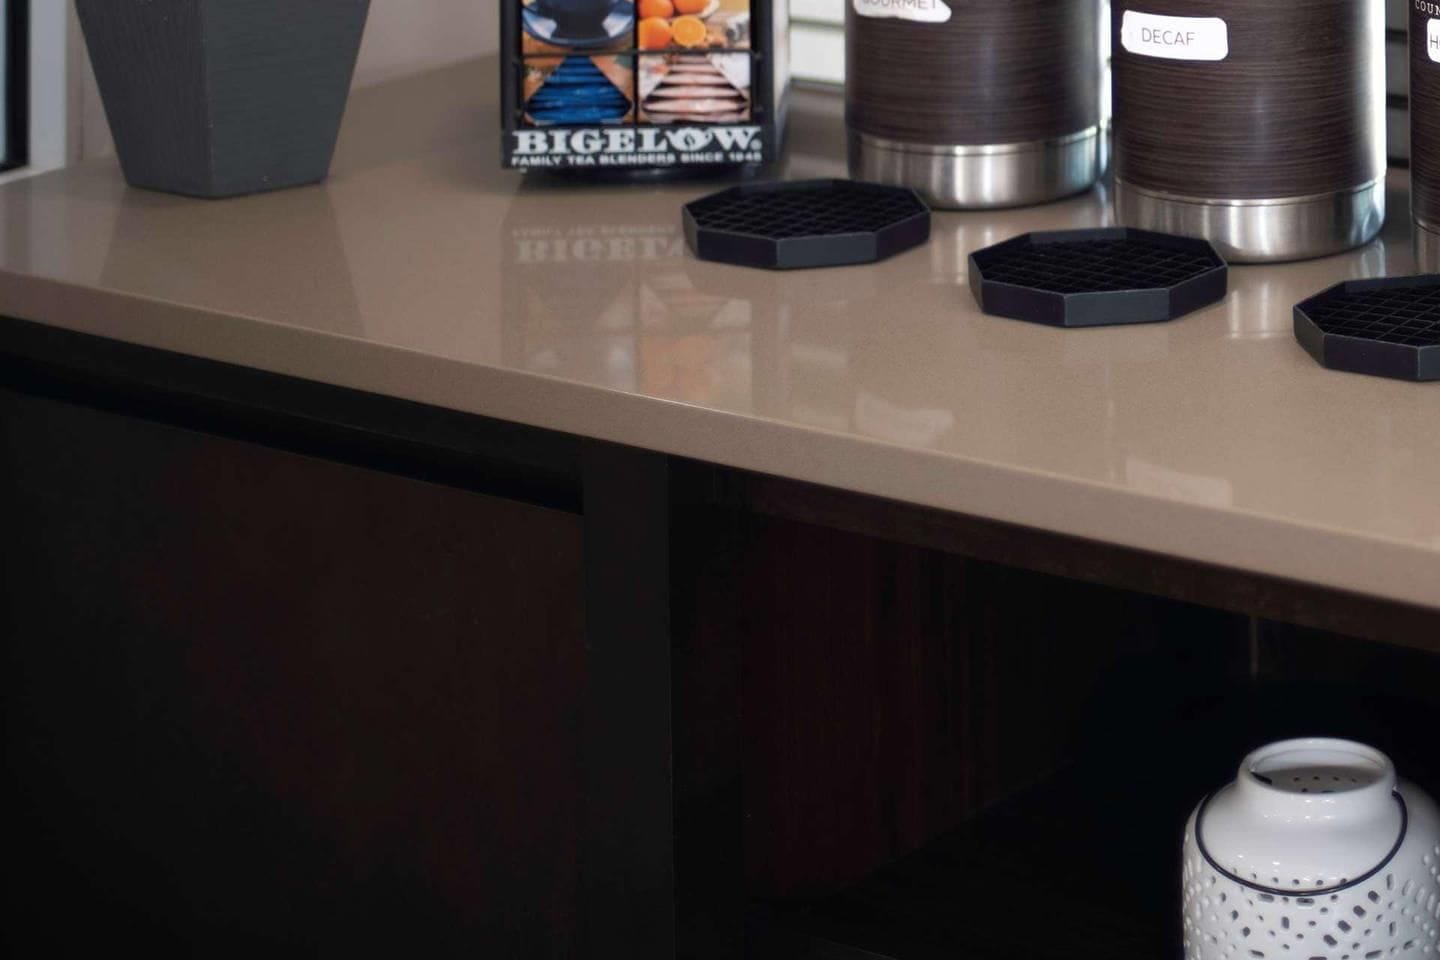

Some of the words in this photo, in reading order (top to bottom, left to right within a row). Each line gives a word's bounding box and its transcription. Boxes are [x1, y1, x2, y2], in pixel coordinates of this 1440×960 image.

[1141, 26, 1196, 47] DECAF
[511, 154, 561, 167] FAMILY
[567, 154, 595, 166] TEA
[599, 153, 676, 165] BLENDERS
[681, 152, 724, 164] SINCE
